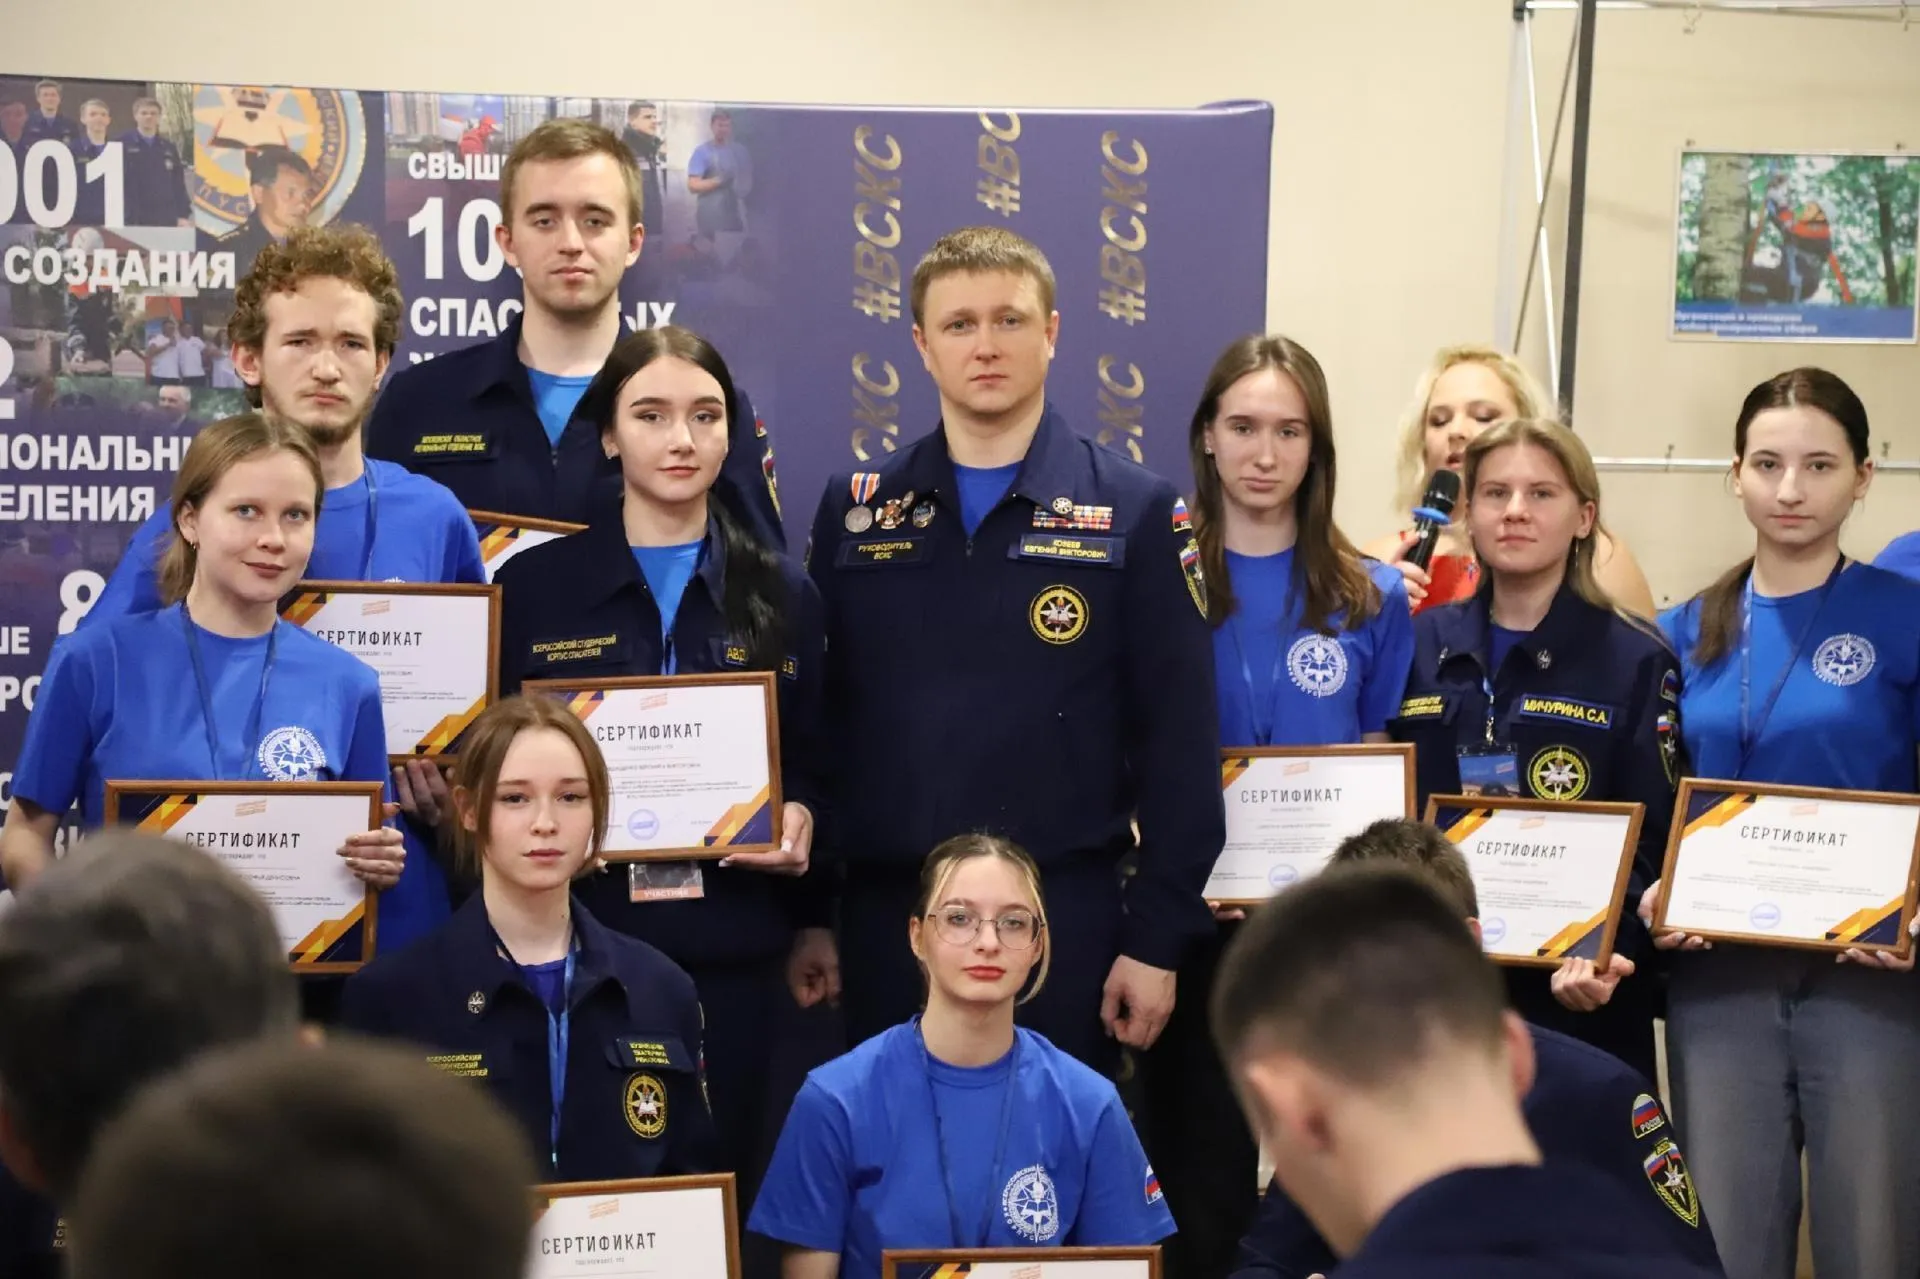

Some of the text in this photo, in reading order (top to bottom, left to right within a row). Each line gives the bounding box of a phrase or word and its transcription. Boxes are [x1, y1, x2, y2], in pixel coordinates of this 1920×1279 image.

[408, 152, 507, 181] СВЫШ
[853, 125, 902, 323] #ВСКС
[1099, 131, 1149, 326] #ВСКС
[408, 197, 523, 282] 10
[4, 246, 236, 294] СОЗДАНИЯ
[316, 629, 424, 647] СЕРТИФИКАТ
[1523, 699, 1585, 719] МИЧУРИНА
[596, 723, 703, 742] СЕРТИФИКАТ
[1240, 788, 1343, 804] СЕРТИФИКАТ
[185, 831, 301, 849] СЕРТИФИКАТ
[1741, 825, 1848, 846] СЕРТИФИКАТ
[1476, 840, 1567, 859] СЕРТИФИКАТ
[541, 1232, 657, 1256] СЕРТИФИКАТ
